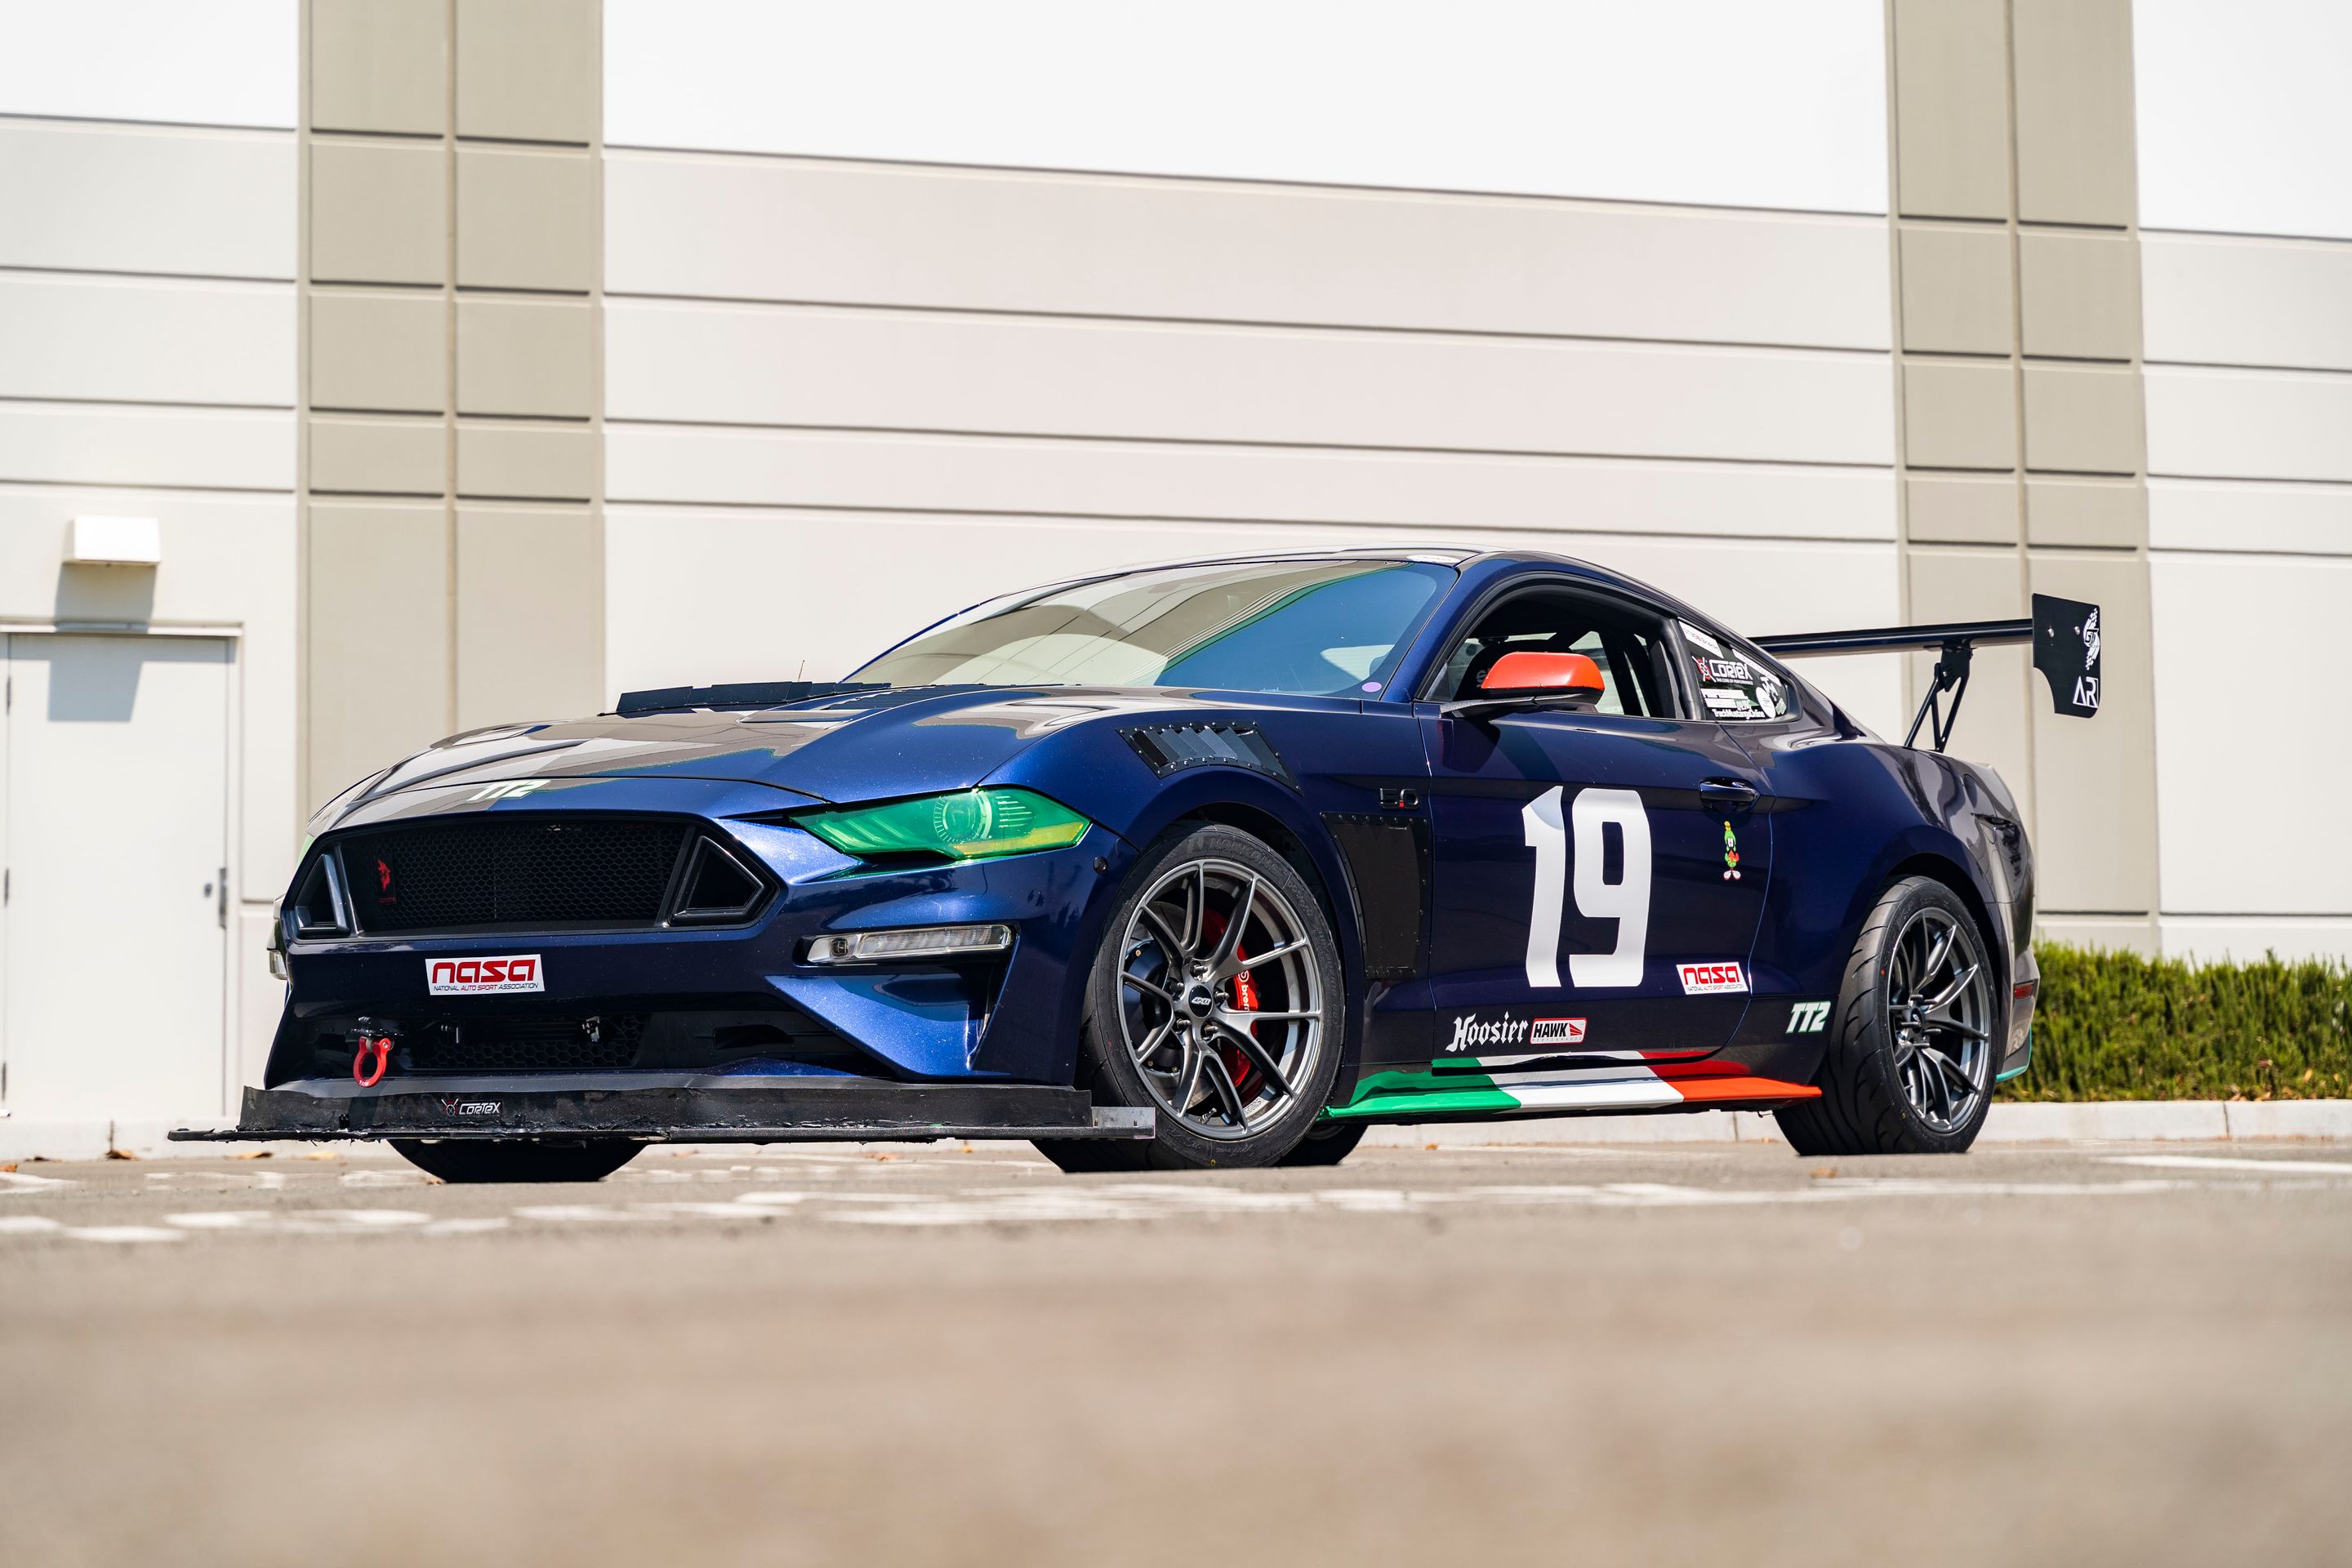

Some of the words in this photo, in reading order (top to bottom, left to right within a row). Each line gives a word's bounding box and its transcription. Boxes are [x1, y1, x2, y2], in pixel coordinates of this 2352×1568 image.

[466, 780, 551, 802] TT2
[1380, 788, 1419, 808] 5.0
[1521, 786, 1652, 987] 19
[1533, 1022, 1569, 1038] HAWK
[1785, 1001, 1831, 1034] TT2
[1445, 1011, 1529, 1052] Hoosier
